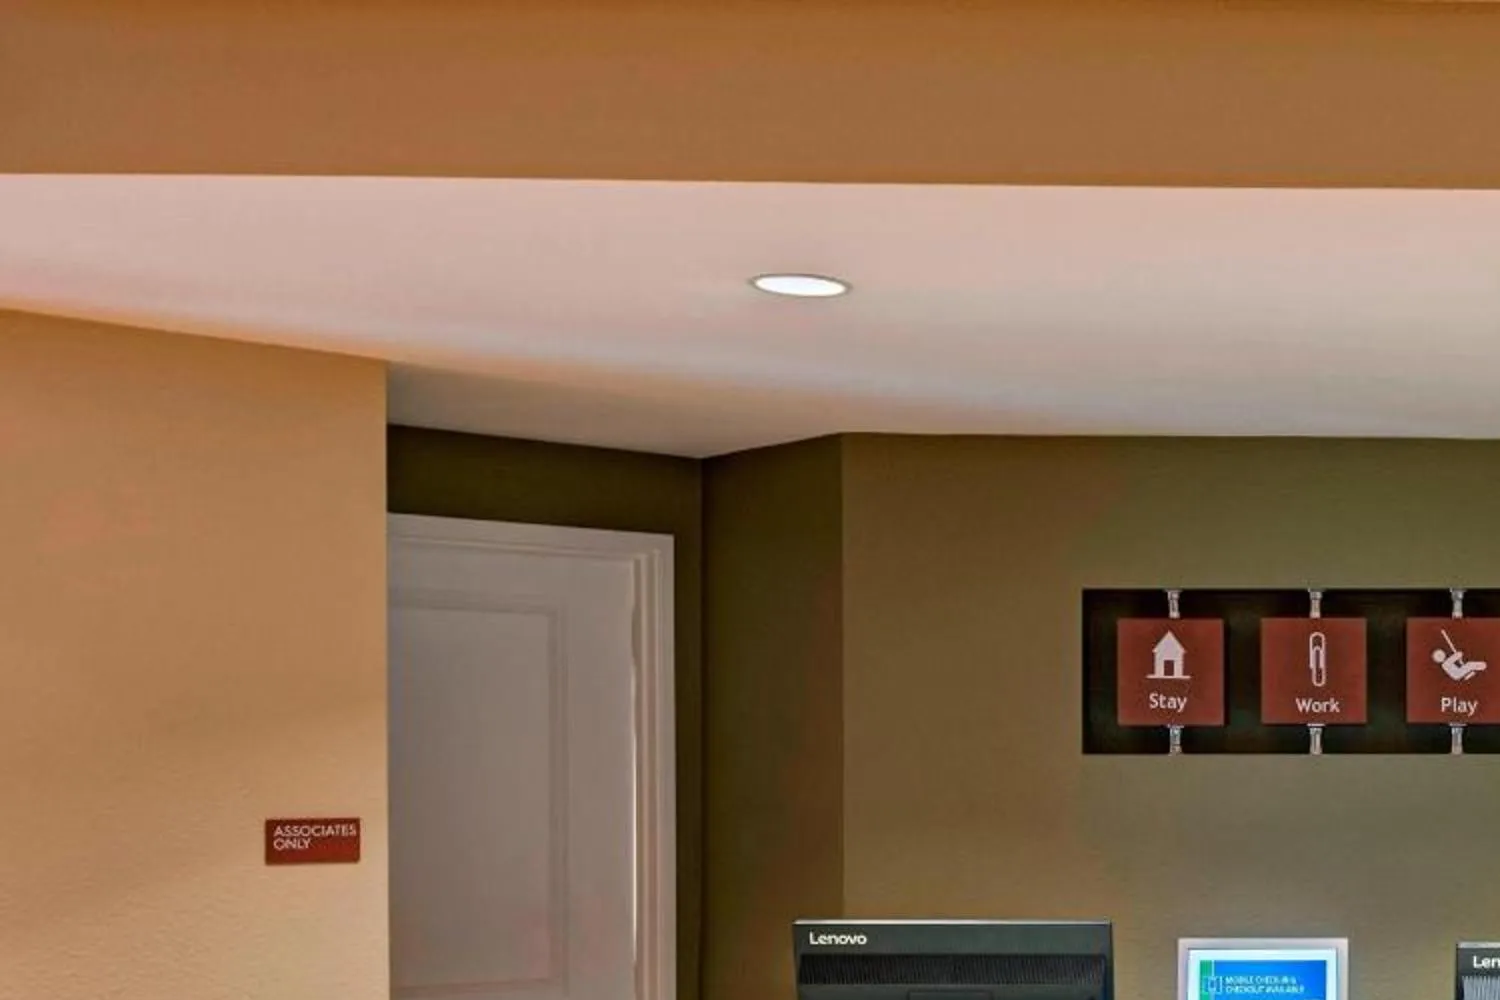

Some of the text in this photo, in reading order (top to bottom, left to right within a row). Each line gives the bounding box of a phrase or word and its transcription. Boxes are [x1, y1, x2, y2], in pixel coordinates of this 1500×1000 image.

[1148, 692, 1187, 711] Stay
[1295, 697, 1341, 714] Work
[1441, 696, 1478, 716] Play
[273, 824, 357, 837] ASSOCIATES
[273, 838, 311, 850] ONLY
[809, 931, 867, 945] Lenovo
